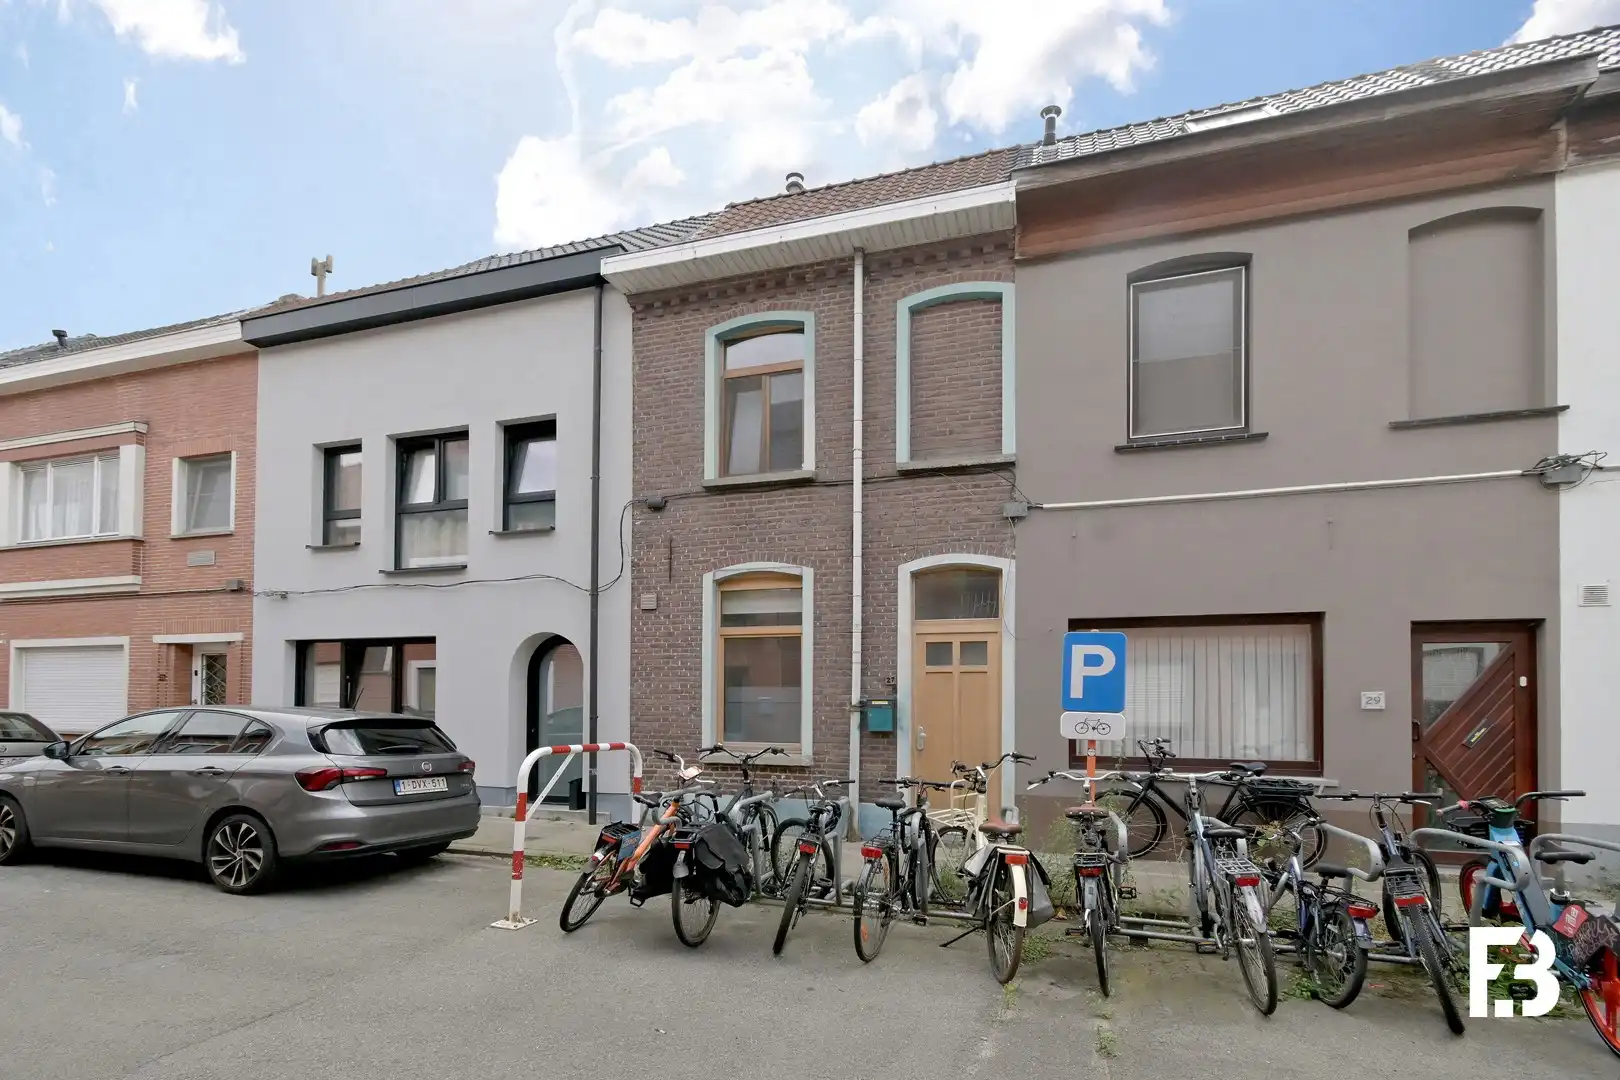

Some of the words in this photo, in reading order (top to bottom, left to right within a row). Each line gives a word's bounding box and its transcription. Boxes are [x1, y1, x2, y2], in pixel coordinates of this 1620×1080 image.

[1070, 645, 1116, 699] P
[886, 676, 895, 684] 27
[1365, 696, 1381, 705] 29
